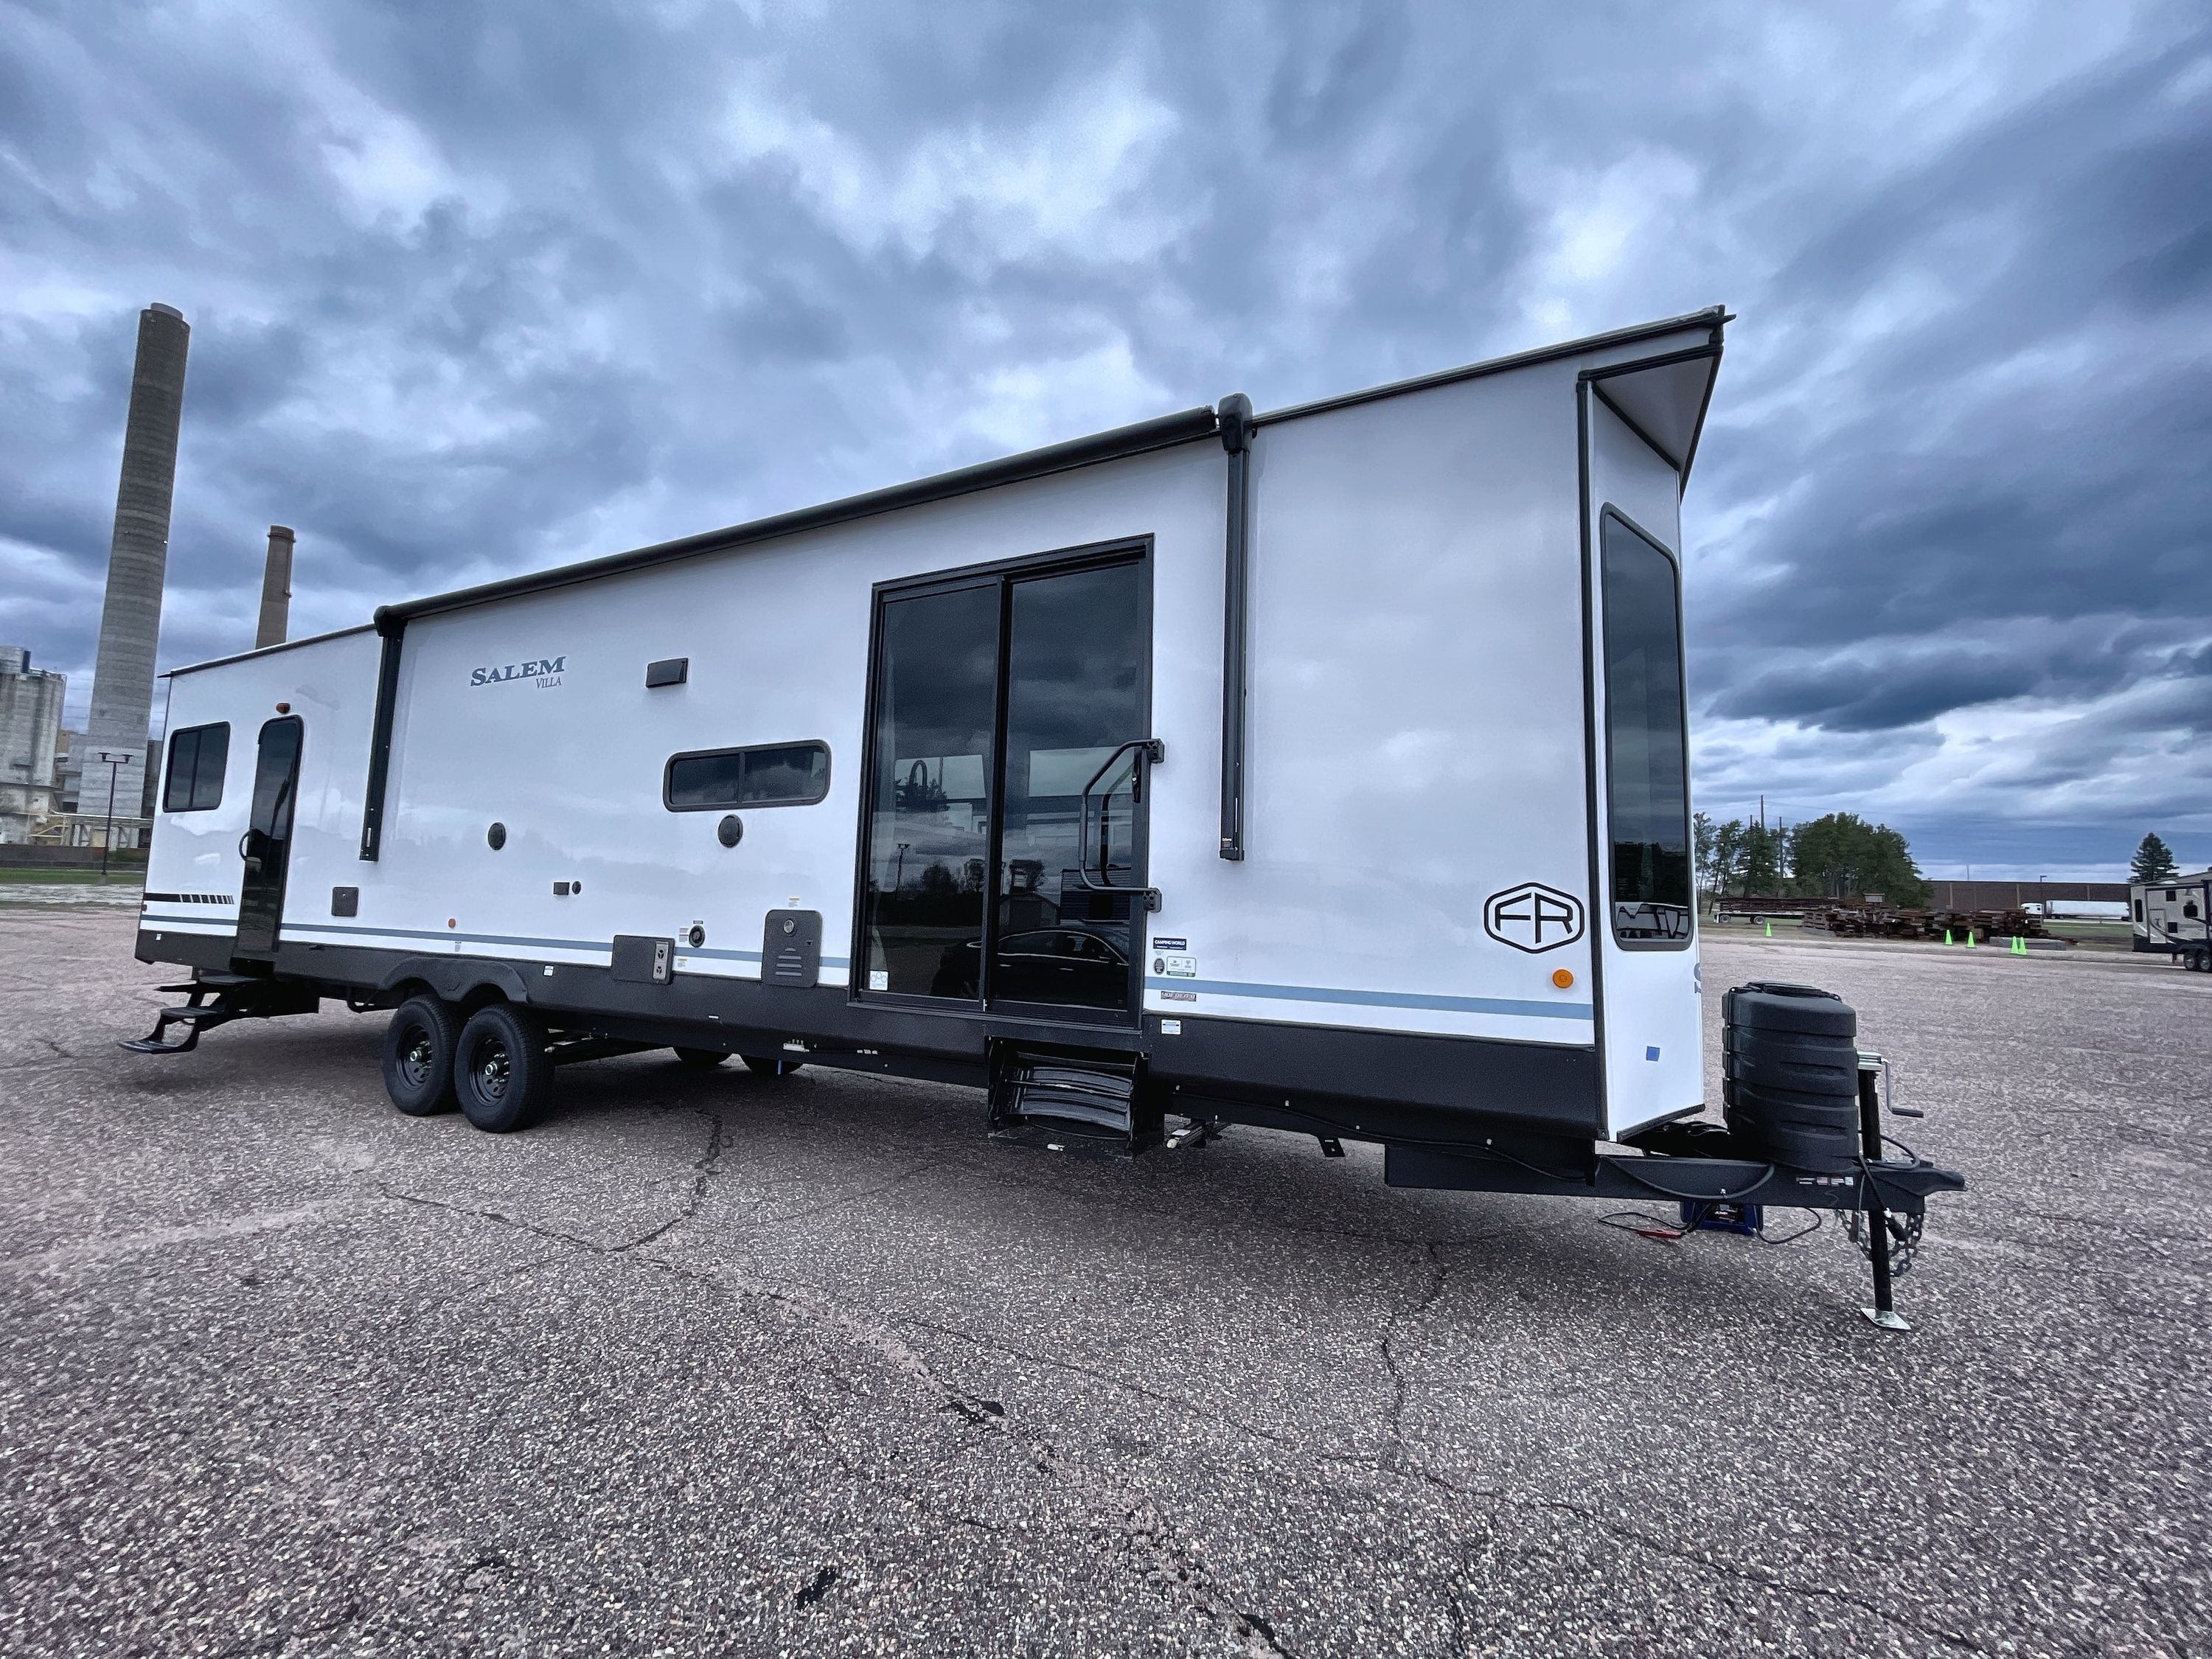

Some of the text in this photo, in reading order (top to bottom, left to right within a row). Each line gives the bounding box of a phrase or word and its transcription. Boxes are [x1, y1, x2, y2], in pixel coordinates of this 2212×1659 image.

[470, 656, 566, 686] SALEM
[536, 676, 562, 689] VILLA
[1495, 892, 1573, 945] FR
